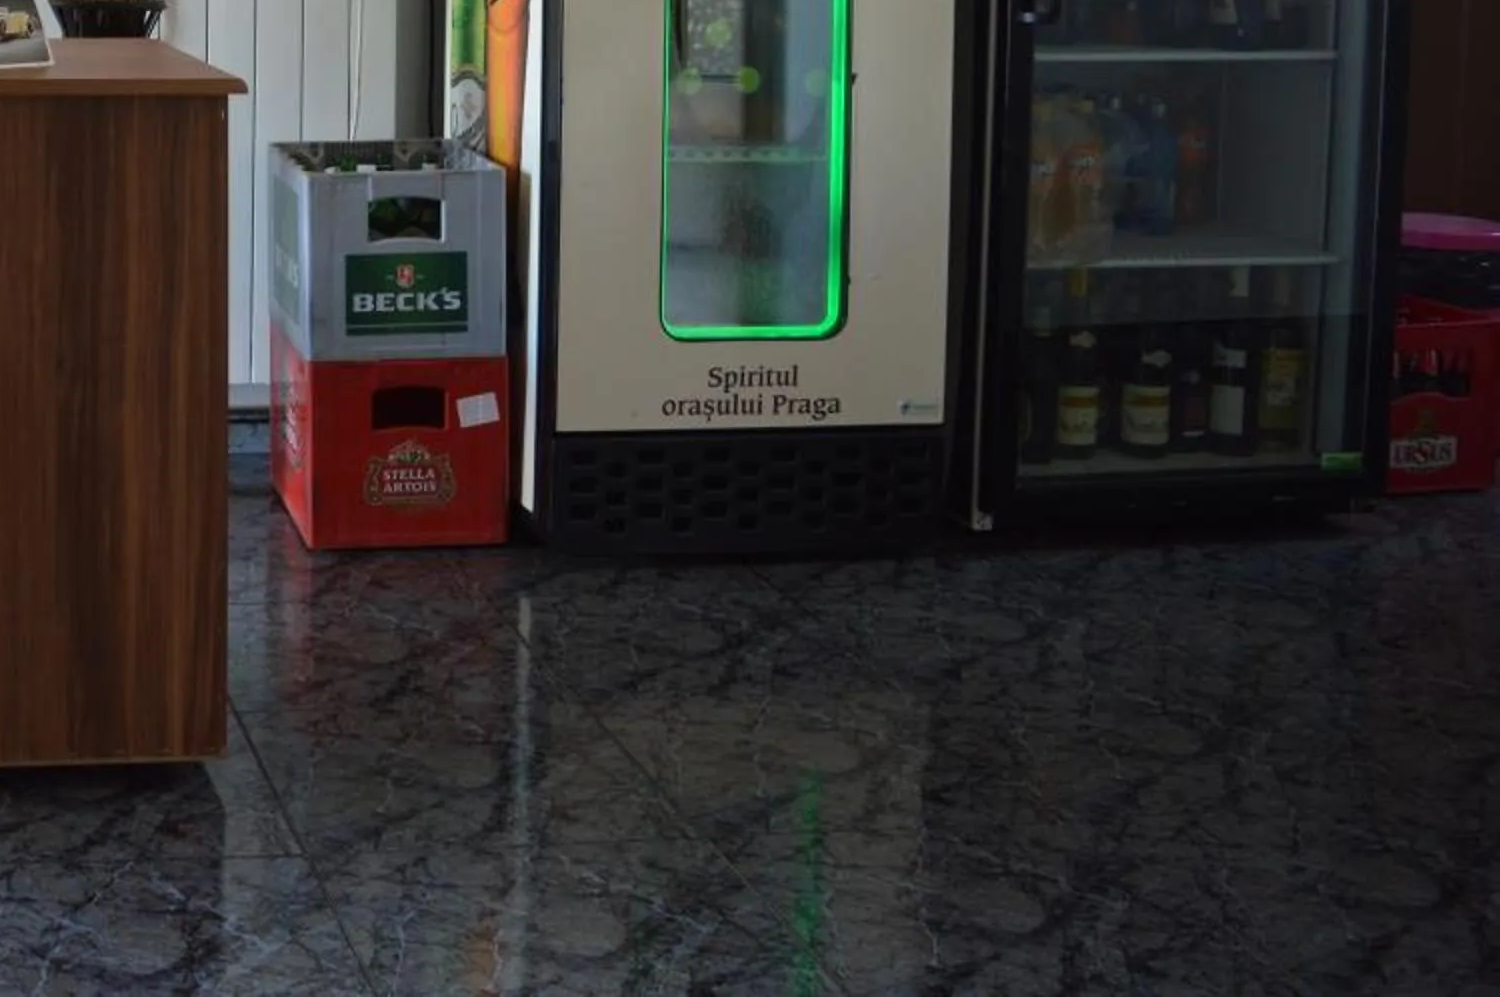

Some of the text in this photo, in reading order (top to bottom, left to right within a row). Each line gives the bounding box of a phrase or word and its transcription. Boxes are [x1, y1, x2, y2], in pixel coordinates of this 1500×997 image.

[352, 286, 461, 313] BECK'S
[707, 364, 798, 393] Spiritul
[772, 393, 841, 421] Praga
[383, 468, 436, 481] STELLA
[383, 480, 437, 494] ARTOIS
